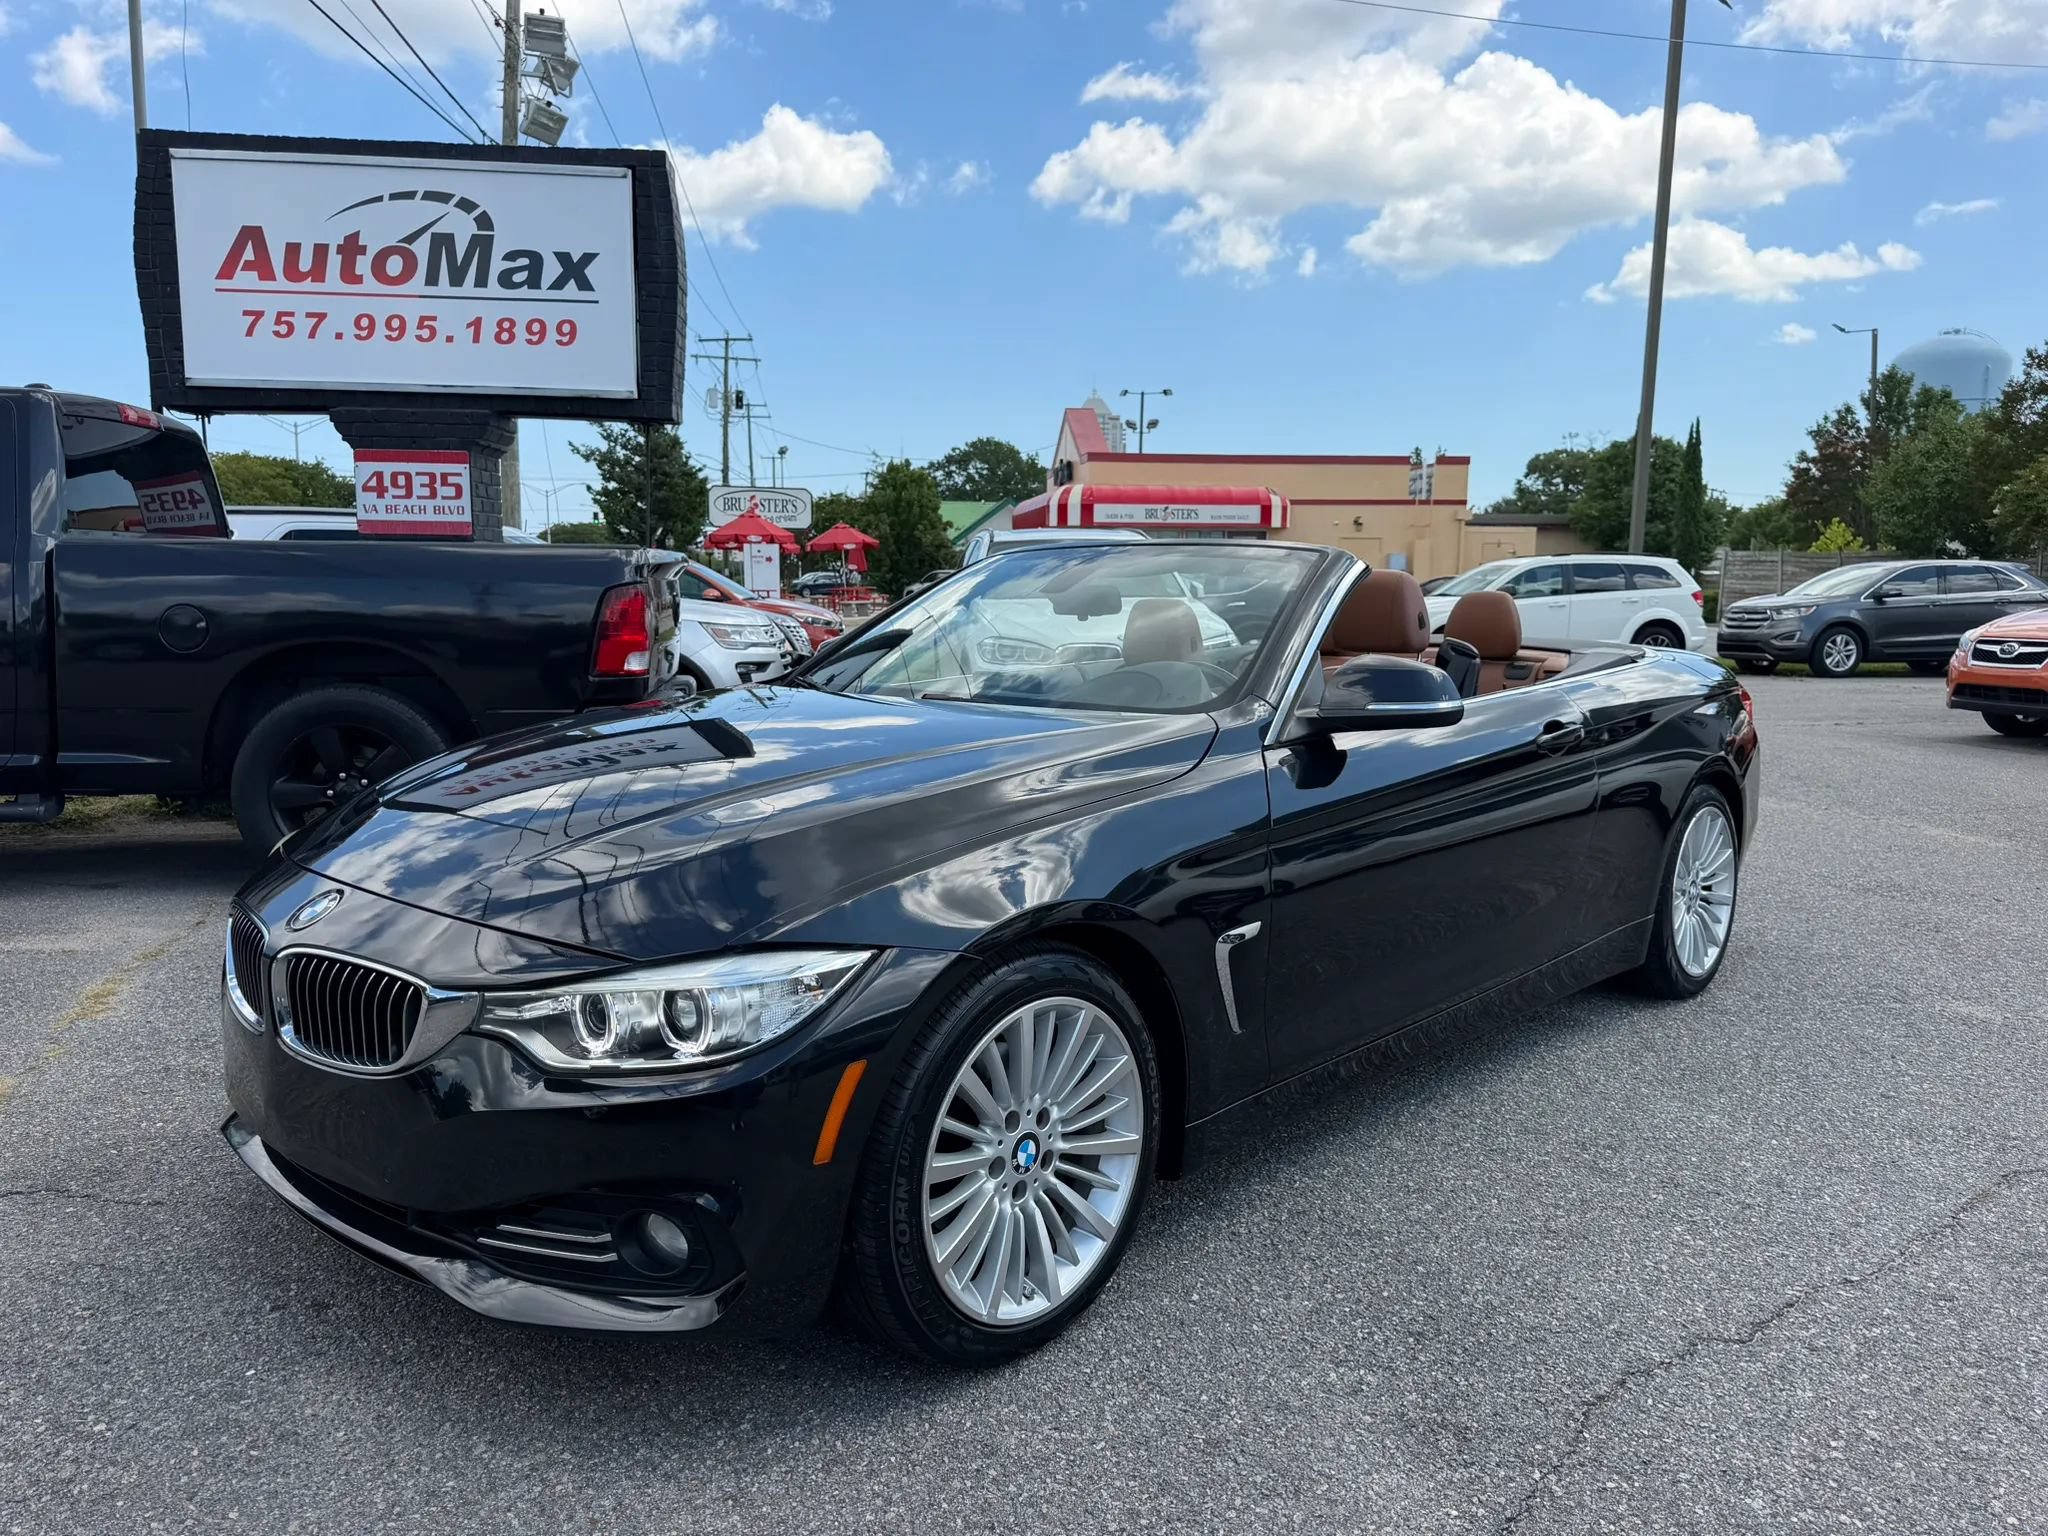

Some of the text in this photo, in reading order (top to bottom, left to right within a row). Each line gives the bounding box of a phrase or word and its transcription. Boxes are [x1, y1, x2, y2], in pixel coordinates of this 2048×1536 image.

[215, 225, 600, 292] AutoMax
[241, 309, 577, 347] 757.995.1899
[361, 470, 464, 501] 4935
[363, 503, 465, 516] VA BEACH BLVD
